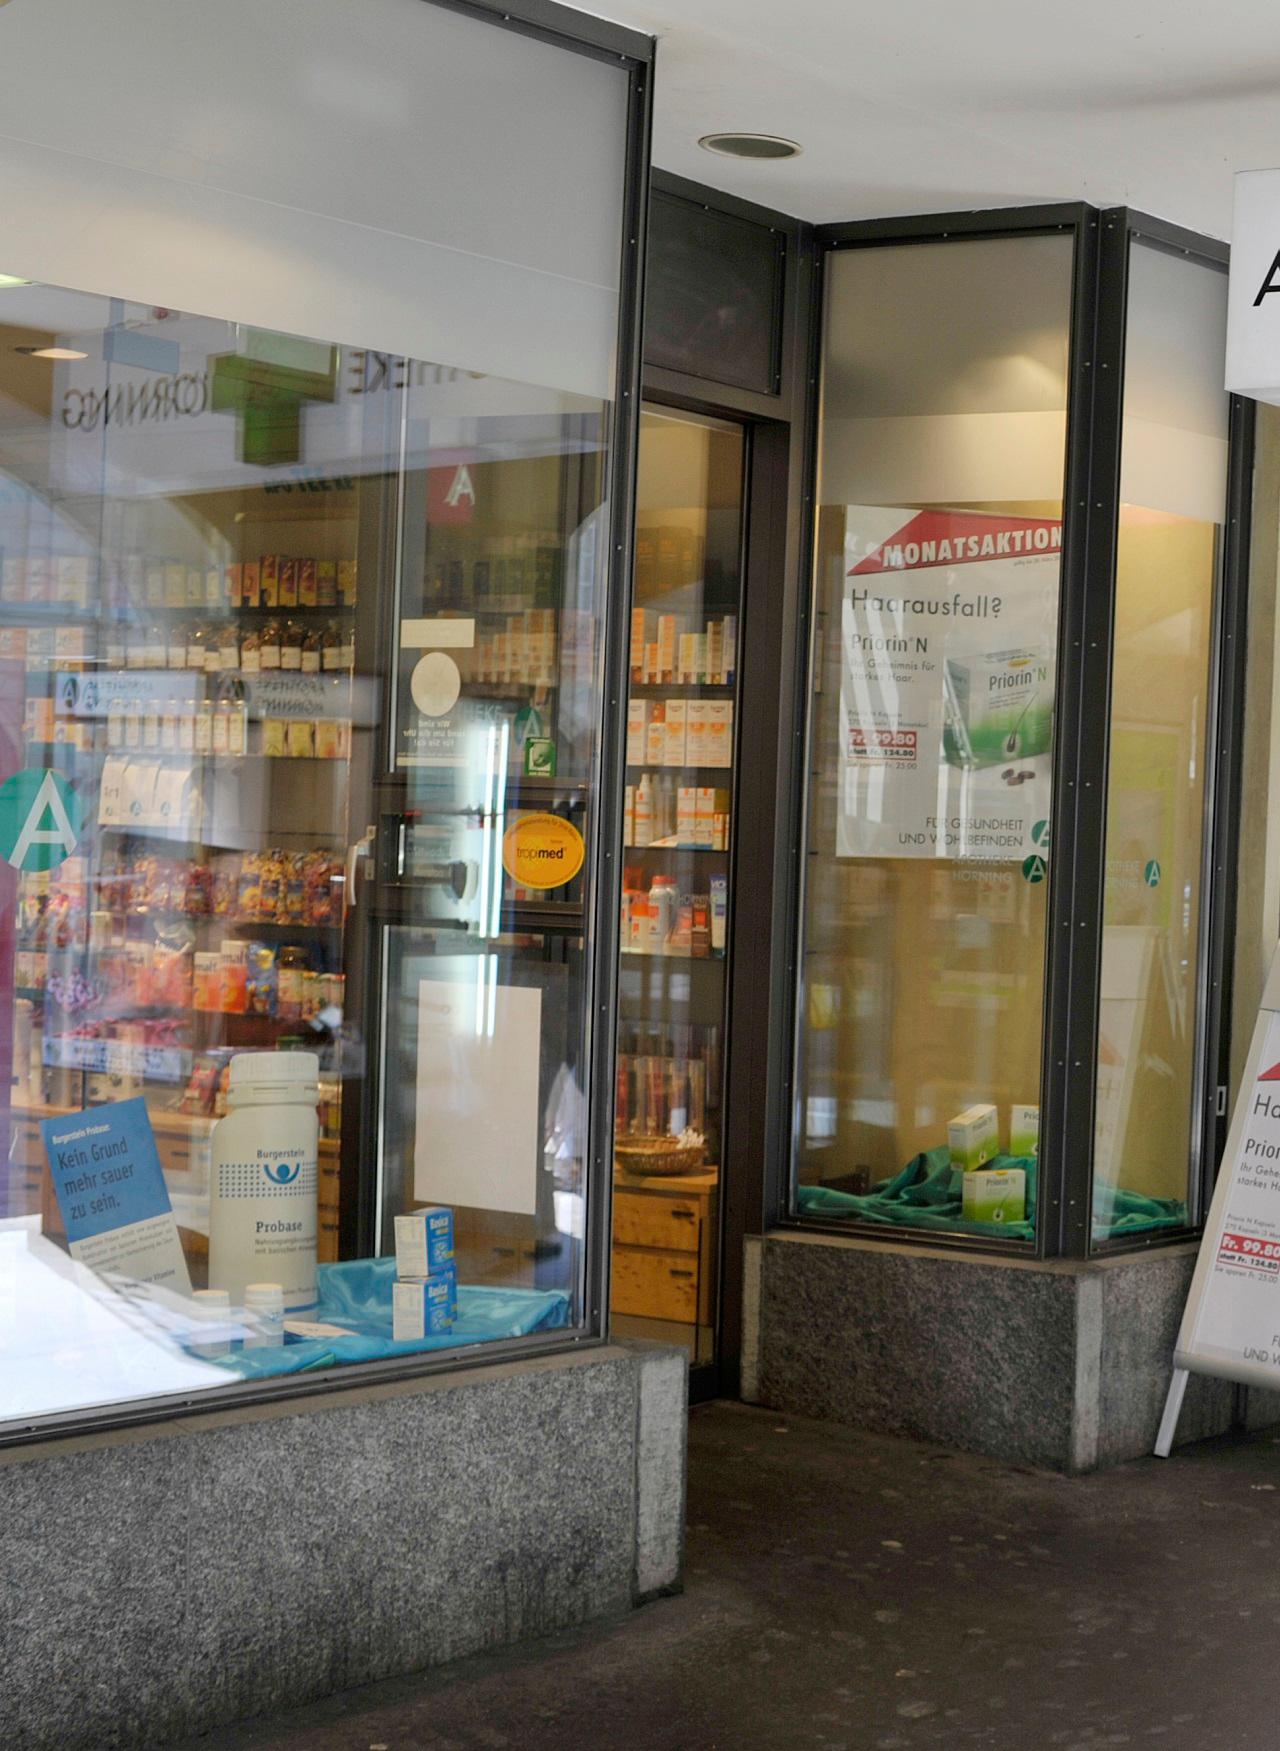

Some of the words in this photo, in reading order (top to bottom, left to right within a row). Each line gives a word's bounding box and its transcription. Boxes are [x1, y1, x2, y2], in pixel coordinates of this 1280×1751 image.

[882, 526, 1062, 568] MONATSAKTION
[851, 588, 1002, 618] Haarausfall?
[852, 634, 908, 652] Priorin
[921, 661, 936, 672] für
[989, 670, 1032, 691] Priorin
[899, 834, 926, 845] UND
[57, 1148, 88, 1171] Kein
[91, 1136, 128, 1162] Grund
[257, 1148, 305, 1160] Burgerstein
[1240, 1162, 1251, 1172] Ihr
[64, 1171, 97, 1196] mehr
[101, 1163, 134, 1186] sauer
[1237, 1177, 1267, 1190] starkes
[70, 1205, 87, 1221] zu
[91, 1192, 121, 1215] sein.
[255, 1220, 303, 1233] Probase
[1222, 1236, 1239, 1250] Fr.
[1220, 1252, 1236, 1260] statt
[1251, 1258, 1278, 1270] 124.80
[1243, 1346, 1269, 1362] UND
